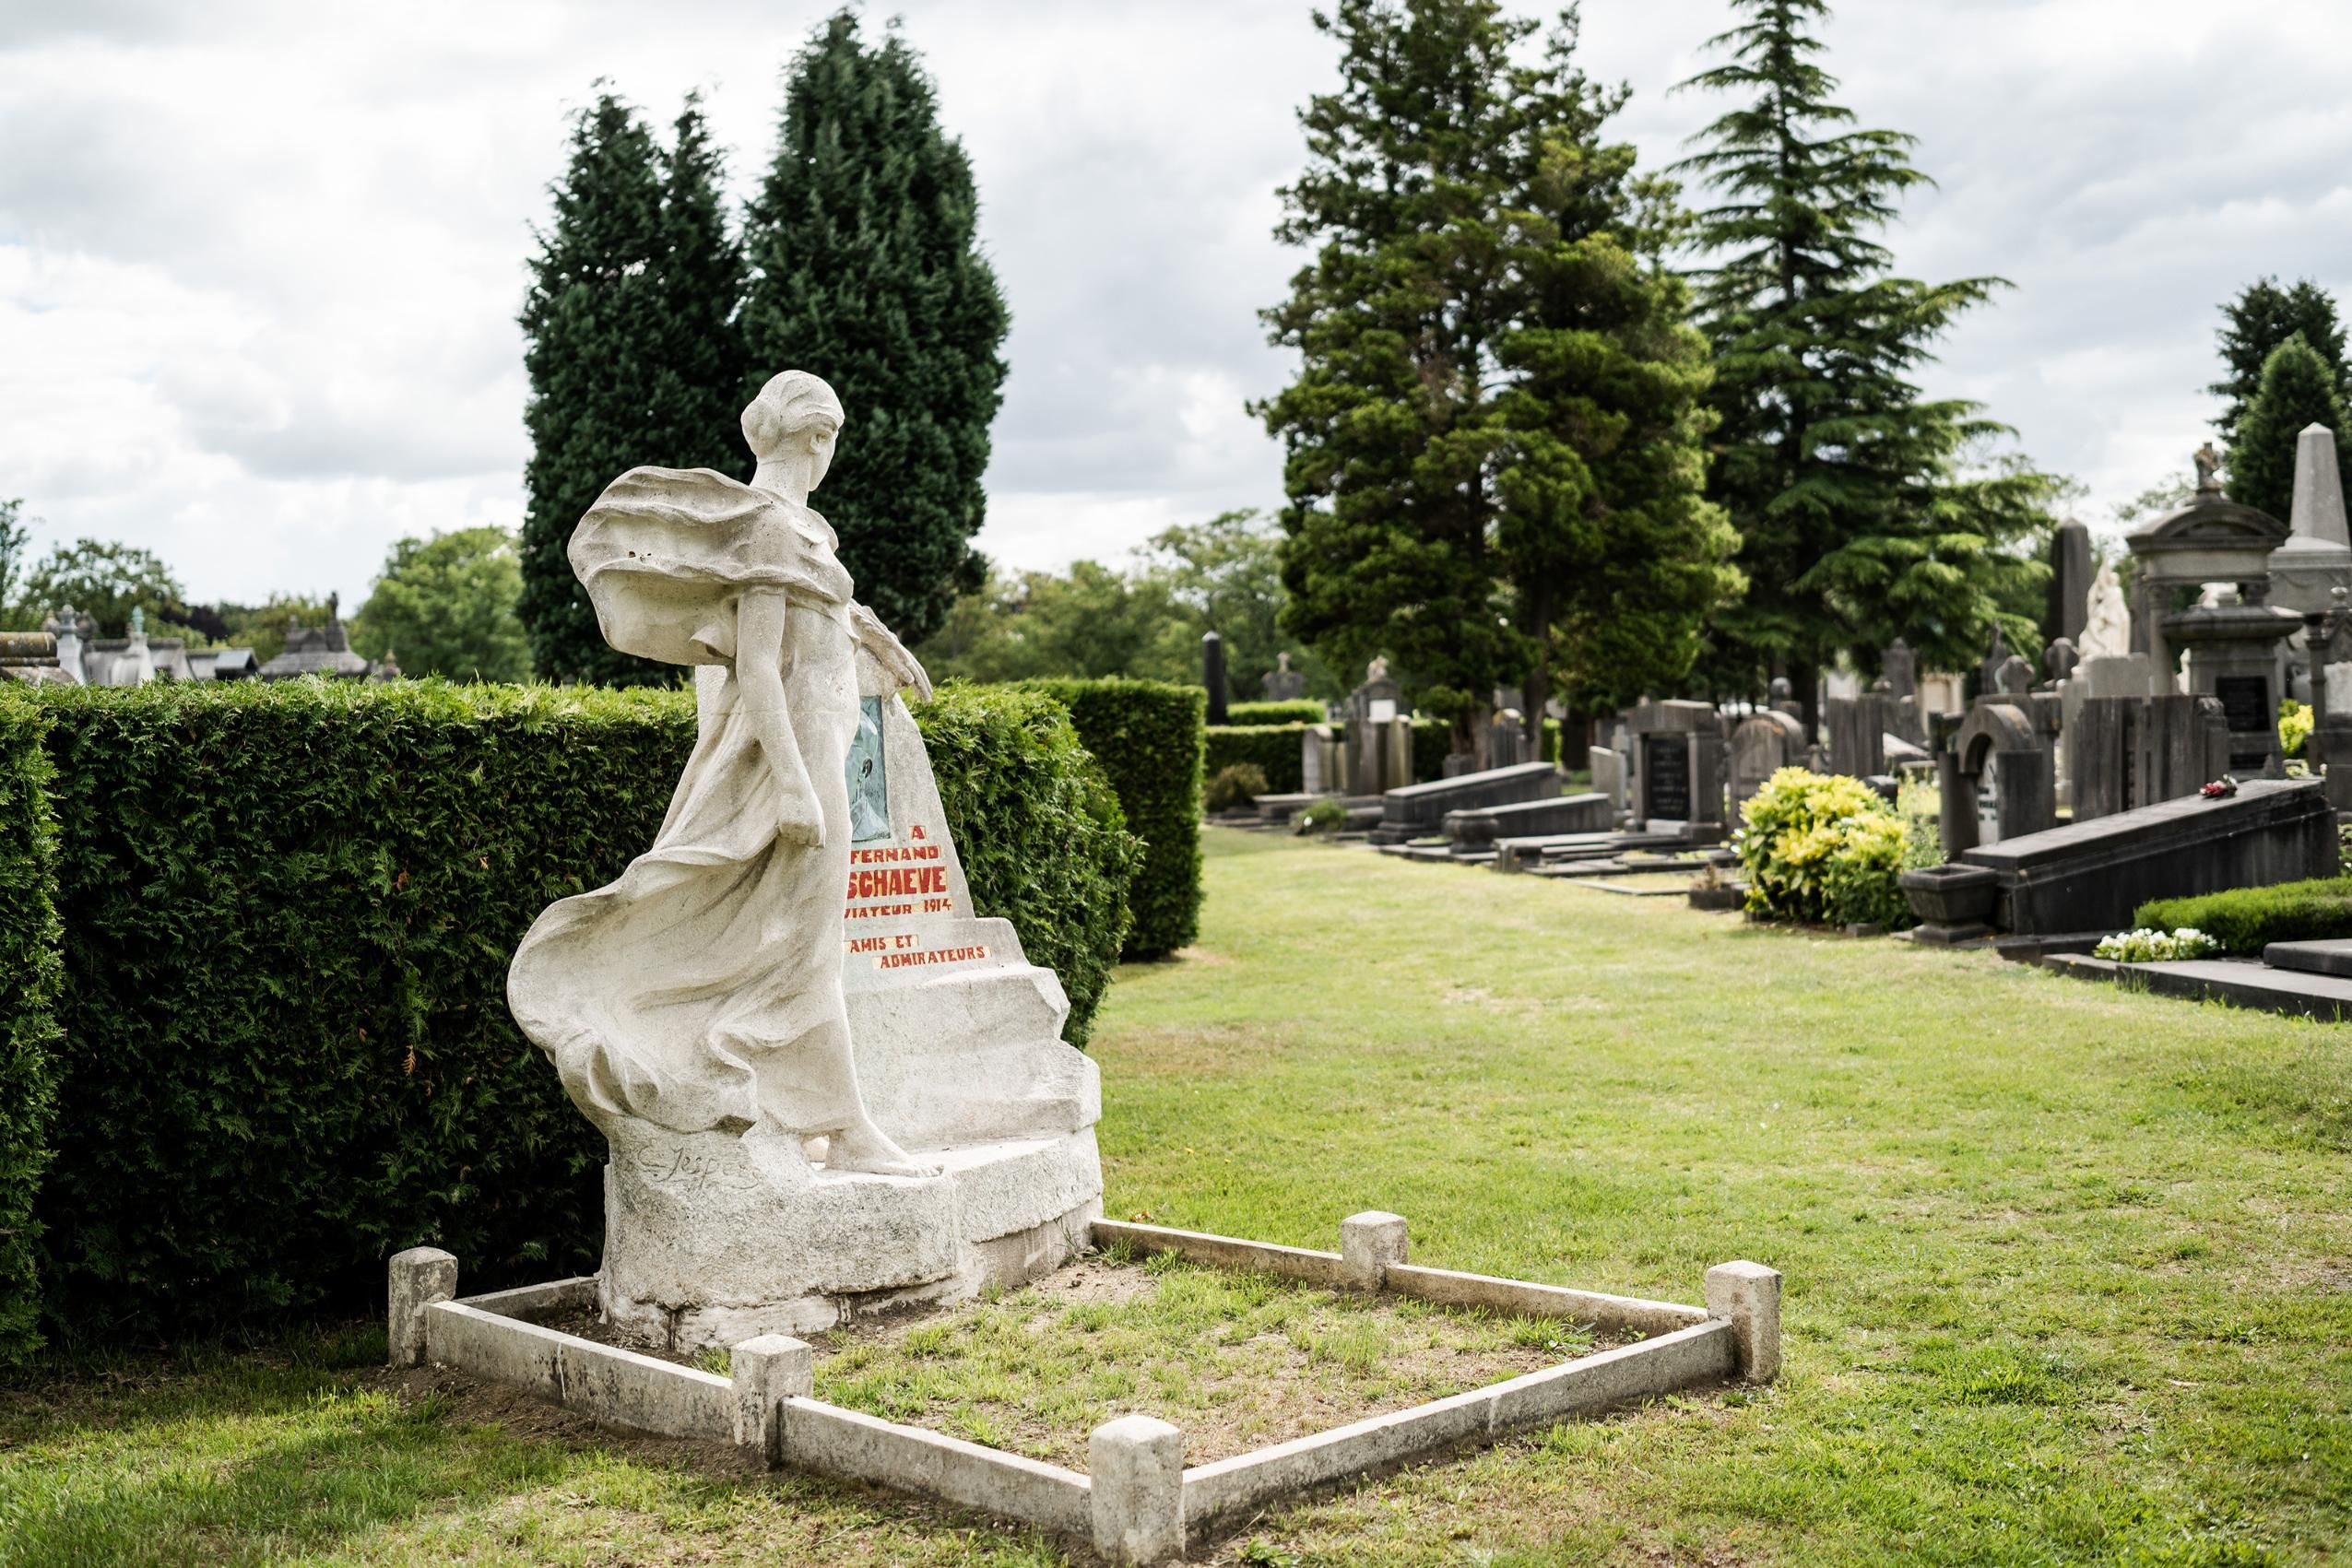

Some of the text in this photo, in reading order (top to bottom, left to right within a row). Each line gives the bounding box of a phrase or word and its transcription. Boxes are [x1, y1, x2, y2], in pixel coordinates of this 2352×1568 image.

[912, 825, 925, 840] A
[851, 845, 939, 865] FERNAND
[847, 867, 946, 900] SCHAEVE
[924, 899, 951, 914] 1914
[850, 935, 912, 953] AMIS ET
[881, 946, 985, 968] ADMIRATEURS
